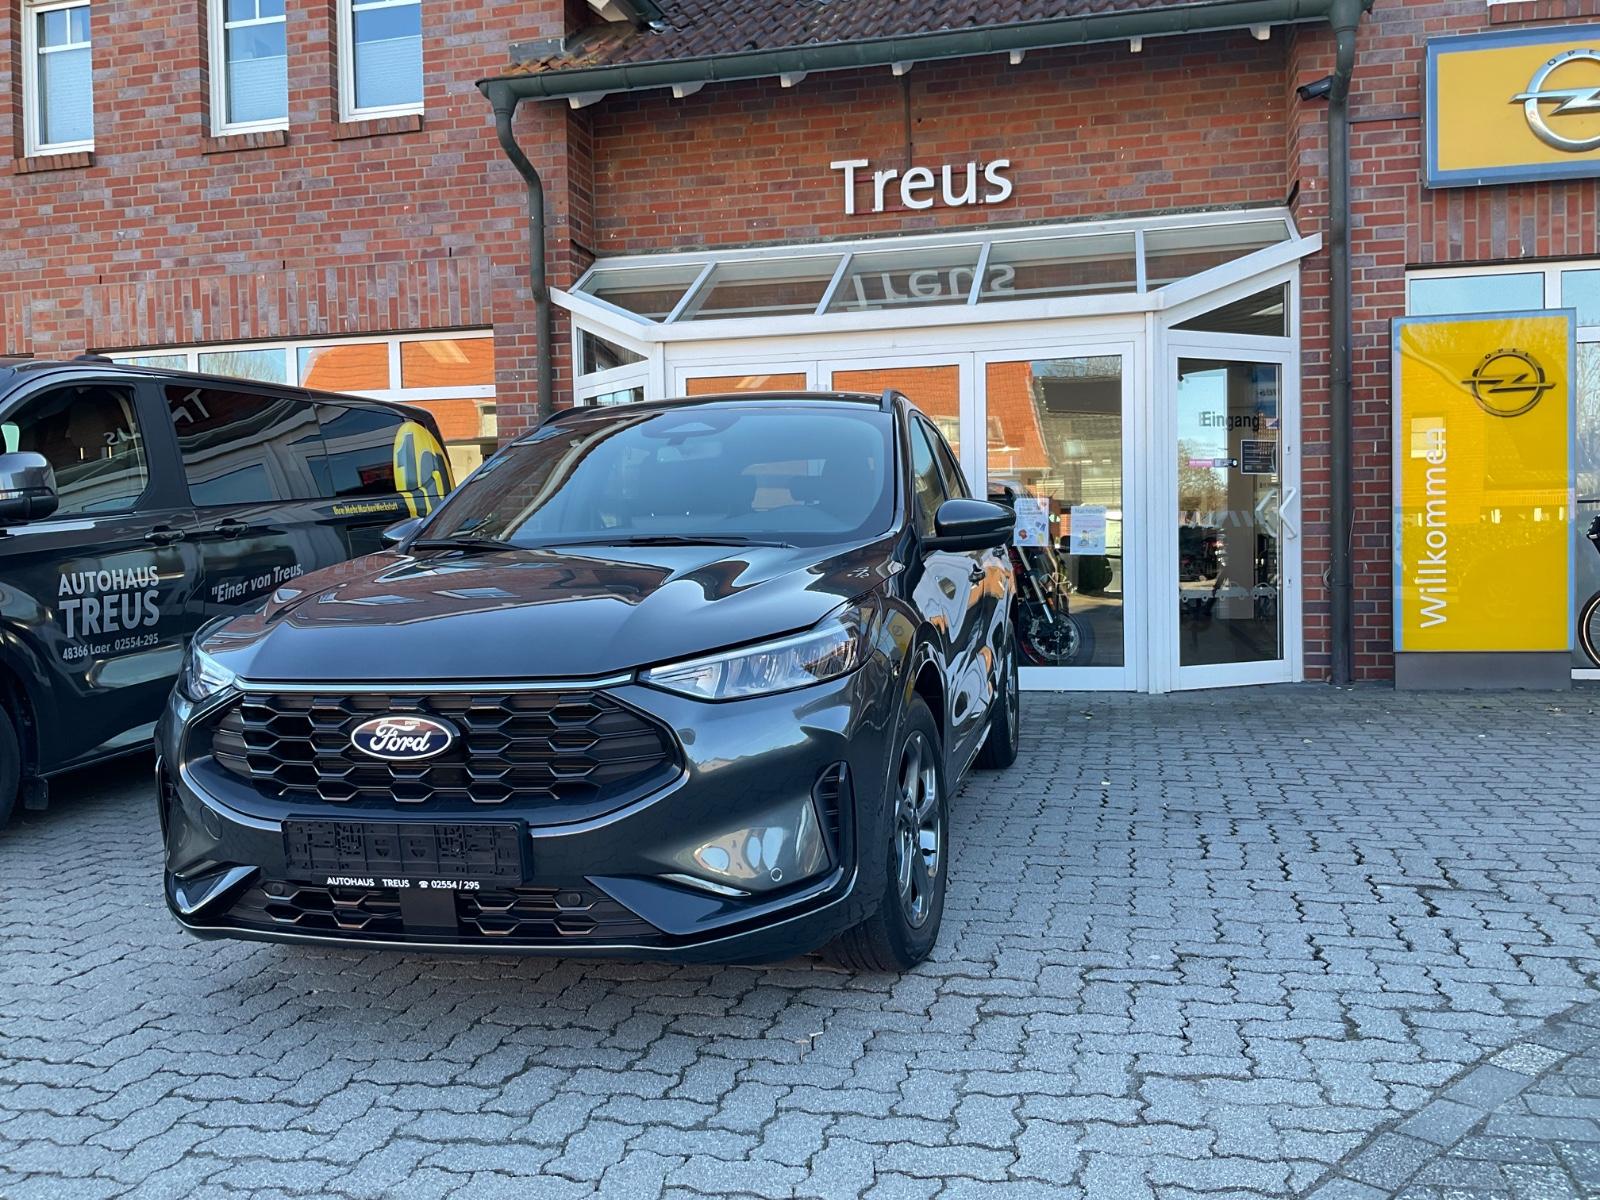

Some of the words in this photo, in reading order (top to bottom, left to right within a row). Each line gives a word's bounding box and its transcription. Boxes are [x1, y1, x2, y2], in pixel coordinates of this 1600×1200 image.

[830, 158, 1013, 214] Treus
[1199, 411, 1260, 432] Eingang
[1417, 427, 1447, 628] Willkommen
[58, 565, 159, 597] AUTOHAUS
[211, 580, 249, 603] "Einer
[250, 573, 271, 591] von
[58, 589, 160, 638] TREUS
[62, 644, 88, 661] 48366
[89, 643, 111, 656] Laer
[114, 632, 159, 651] 02554-295
[369, 723, 432, 752] Ford
[326, 876, 375, 887] AUTOHAUS
[382, 878, 410, 888] TREUS
[430, 880, 457, 889] 02554
[463, 881, 480, 890] 295
